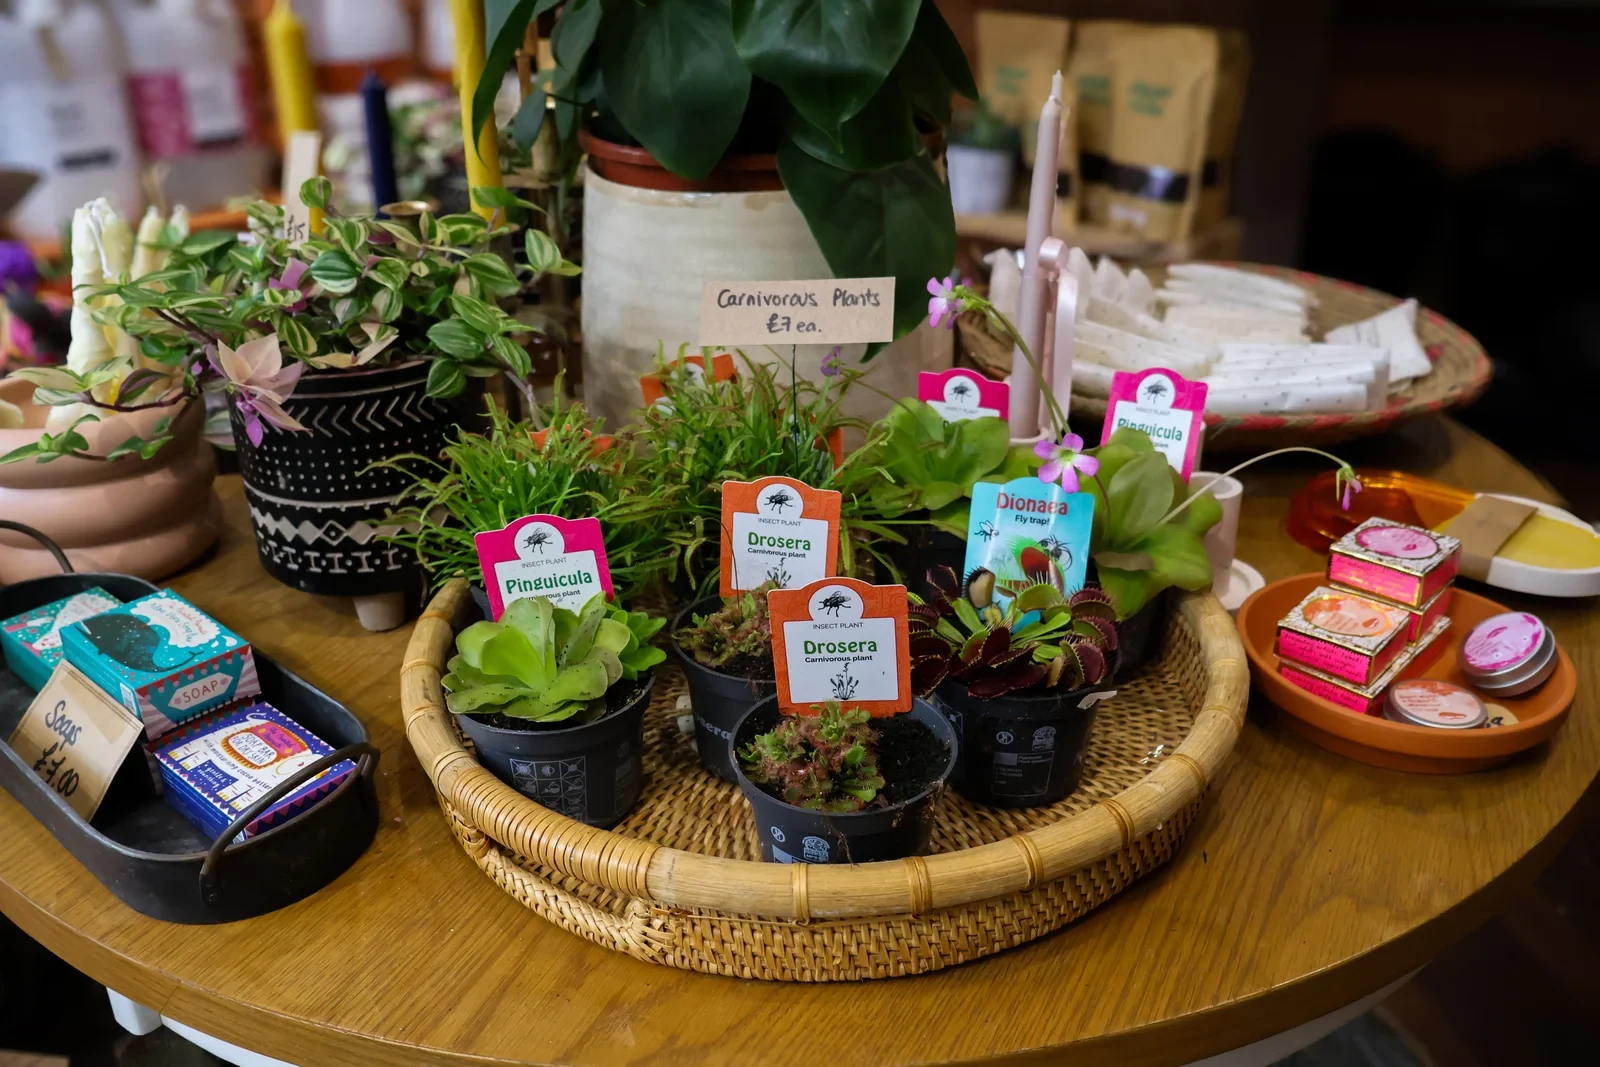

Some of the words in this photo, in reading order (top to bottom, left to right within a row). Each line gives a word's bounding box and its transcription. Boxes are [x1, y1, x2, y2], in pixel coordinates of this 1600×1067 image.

[717, 288, 818, 309] Carnivorous
[833, 287, 881, 308] Plants
[766, 313, 791, 333] £7
[797, 320, 822, 333] ea.
[997, 492, 1068, 516] Dionaea
[758, 517, 780, 525] INSECT
[781, 519, 802, 527] PLANT
[1015, 514, 1027, 525] Fly
[1030, 516, 1051, 526] trap!
[748, 531, 811, 551] Drosera
[521, 560, 544, 568] INSECT
[545, 556, 567, 565] PLANT
[747, 547, 787, 557] Carnivorous
[788, 551, 806, 559] plant
[505, 570, 593, 594] Pinguicula
[562, 589, 581, 598] plant
[813, 622, 838, 630] INSECT
[840, 621, 864, 629] PLANT
[803, 640, 878, 655] Drosera
[852, 655, 873, 663] plant
[182, 680, 219, 703] SOAP
[45, 700, 82, 751] Soaps
[238, 744, 254, 758] DRY
[248, 754, 267, 766] SKIN
[242, 733, 261, 749] SOAP
[259, 746, 276, 760] BAR
[237, 768, 254, 780] cocoa
[252, 777, 273, 790] butter
